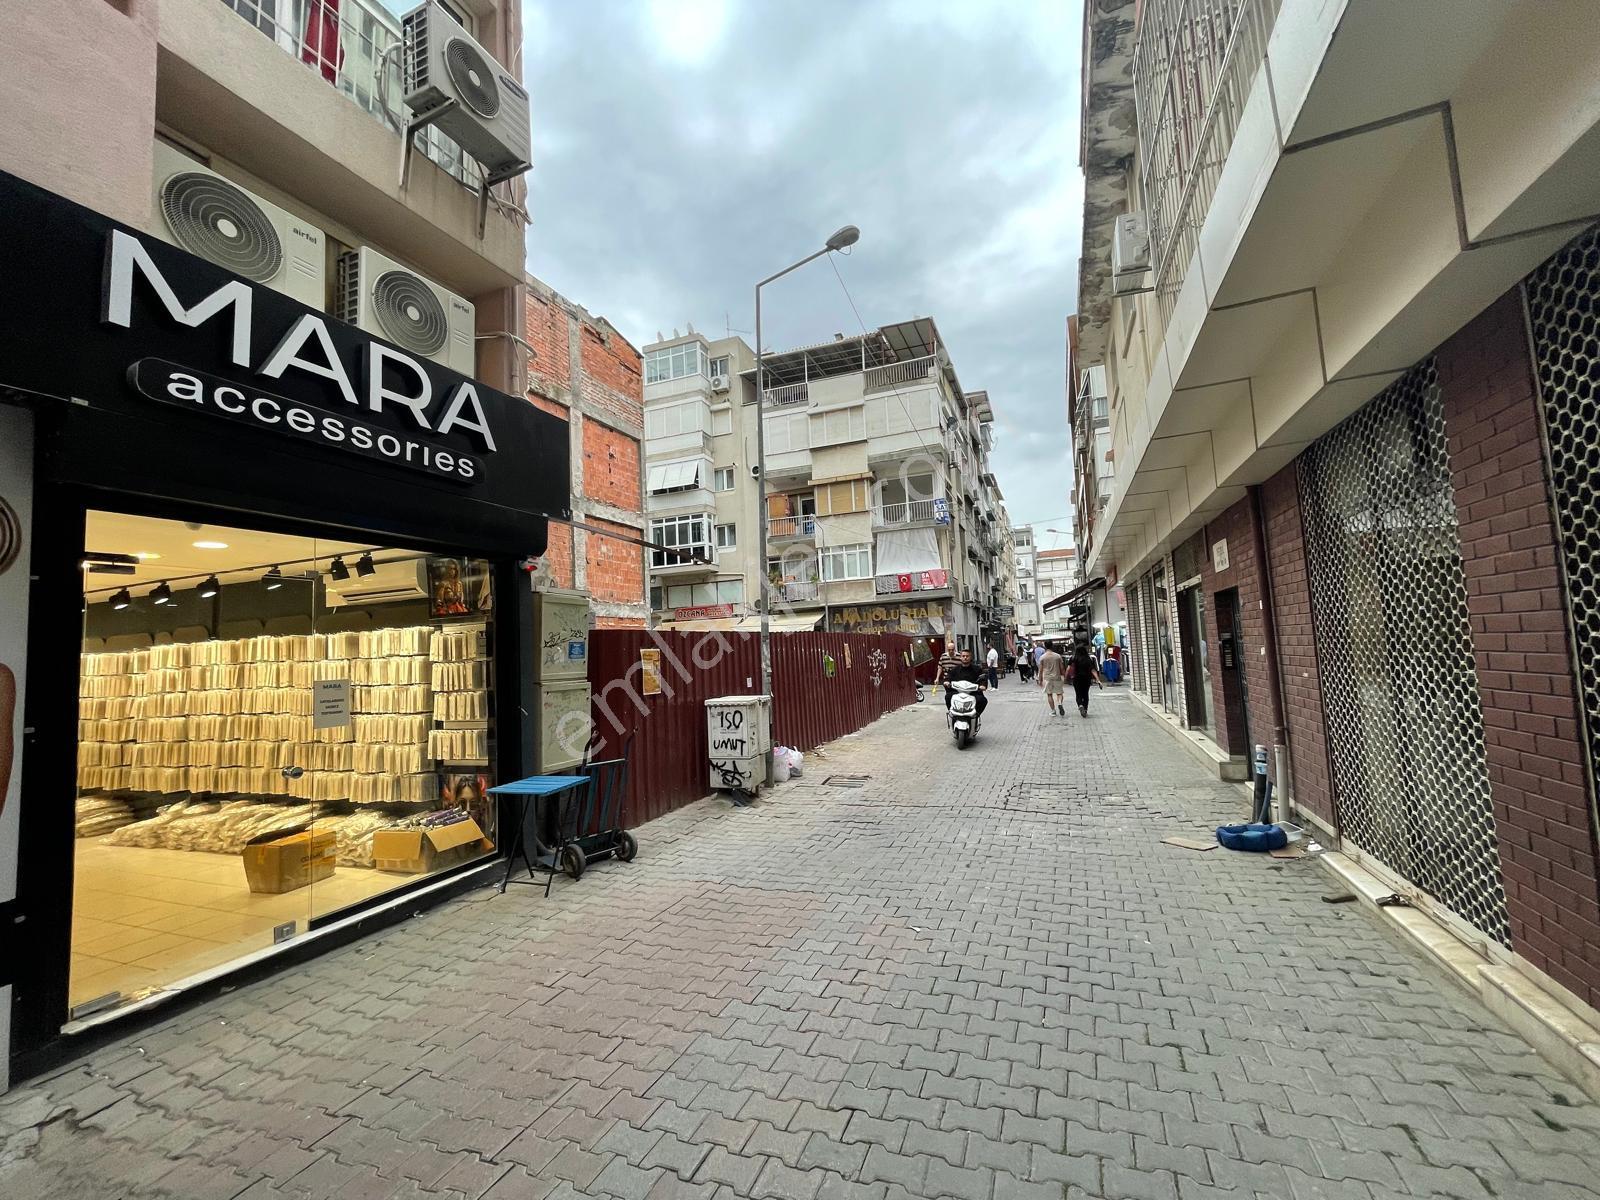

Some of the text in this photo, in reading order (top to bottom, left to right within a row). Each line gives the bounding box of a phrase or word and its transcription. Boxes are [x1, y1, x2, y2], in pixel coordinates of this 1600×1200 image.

[293, 228, 317, 244] airfel
[104, 229, 497, 452] MARA
[167, 372, 476, 478] accessories
